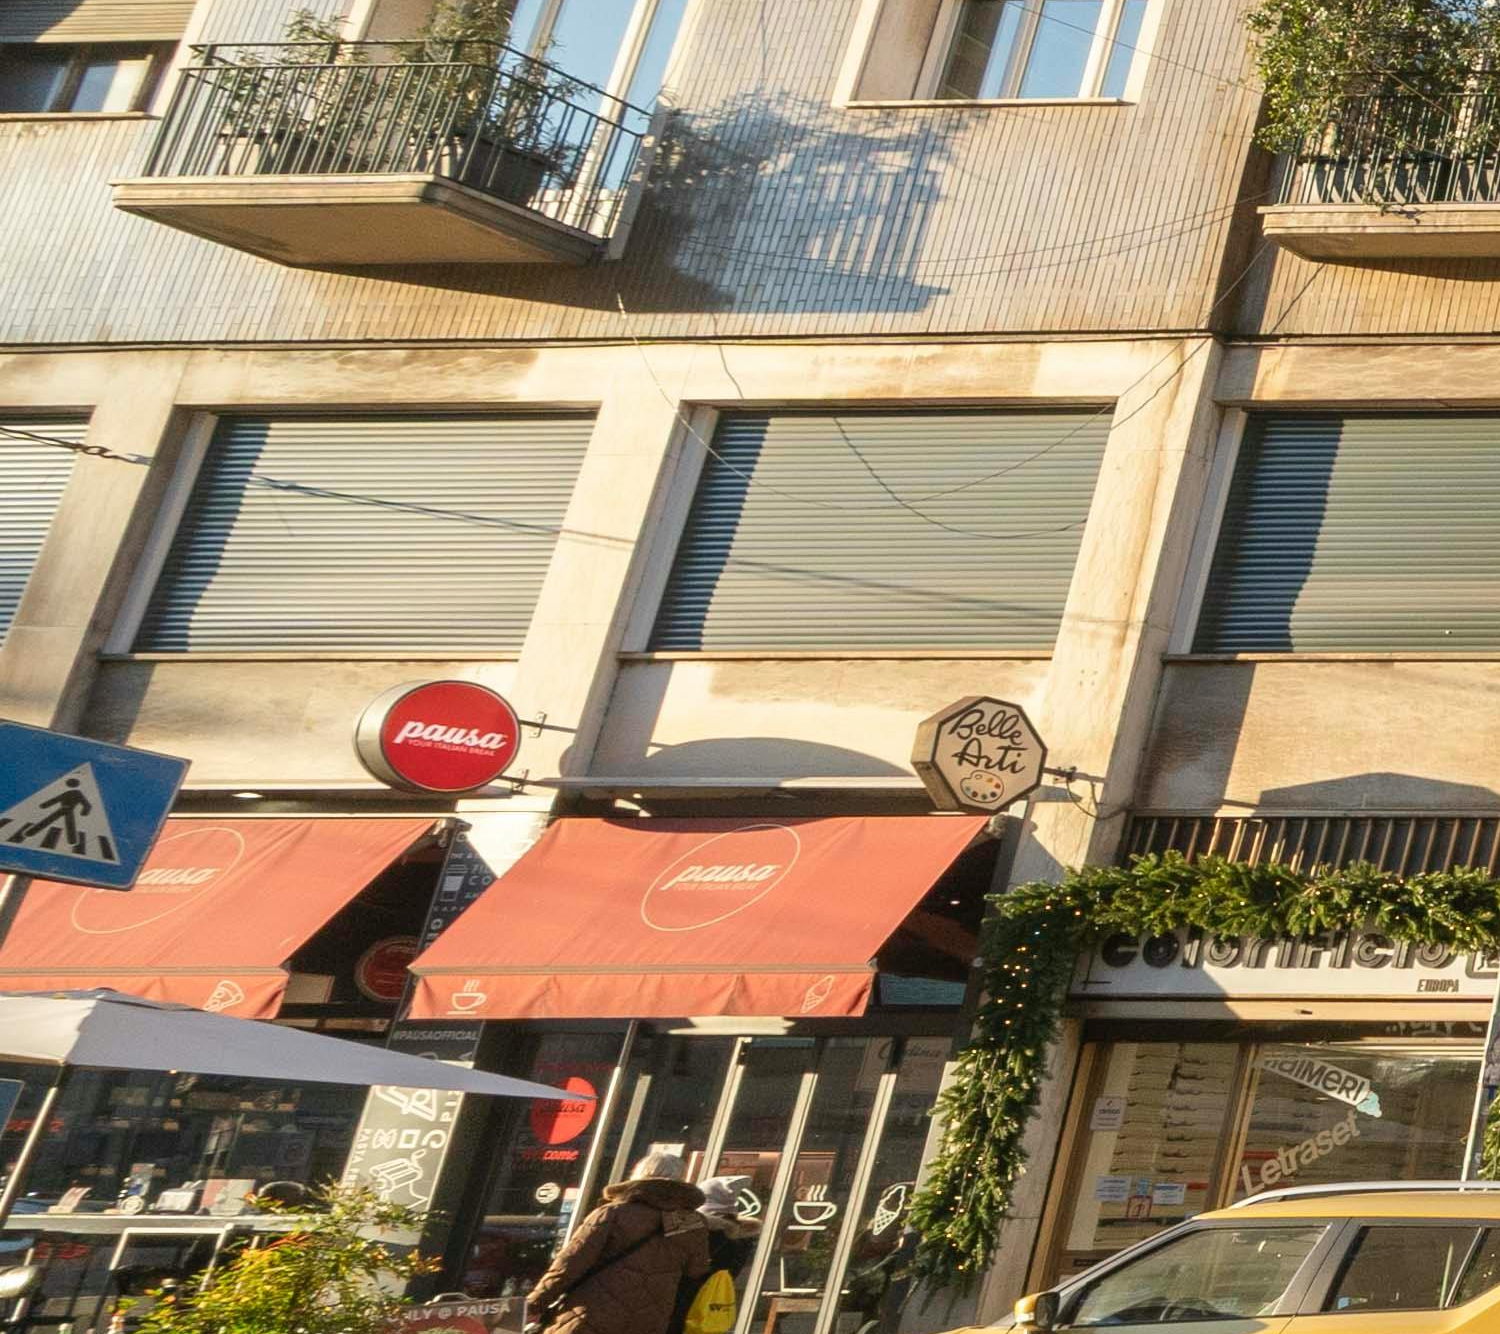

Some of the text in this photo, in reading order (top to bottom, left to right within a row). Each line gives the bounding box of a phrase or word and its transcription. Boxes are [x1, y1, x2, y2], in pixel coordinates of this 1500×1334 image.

[392, 720, 508, 750] pausa
[948, 708, 1024, 746] Belle
[951, 737, 1028, 774] Arti
[136, 867, 221, 885] ausa
[659, 863, 782, 891] pausa
[1416, 978, 1459, 993] EUROPA
[1241, 1112, 1361, 1197] Letraset
[438, 1308, 452, 1318] @
[456, 1302, 511, 1317] PAUSA
